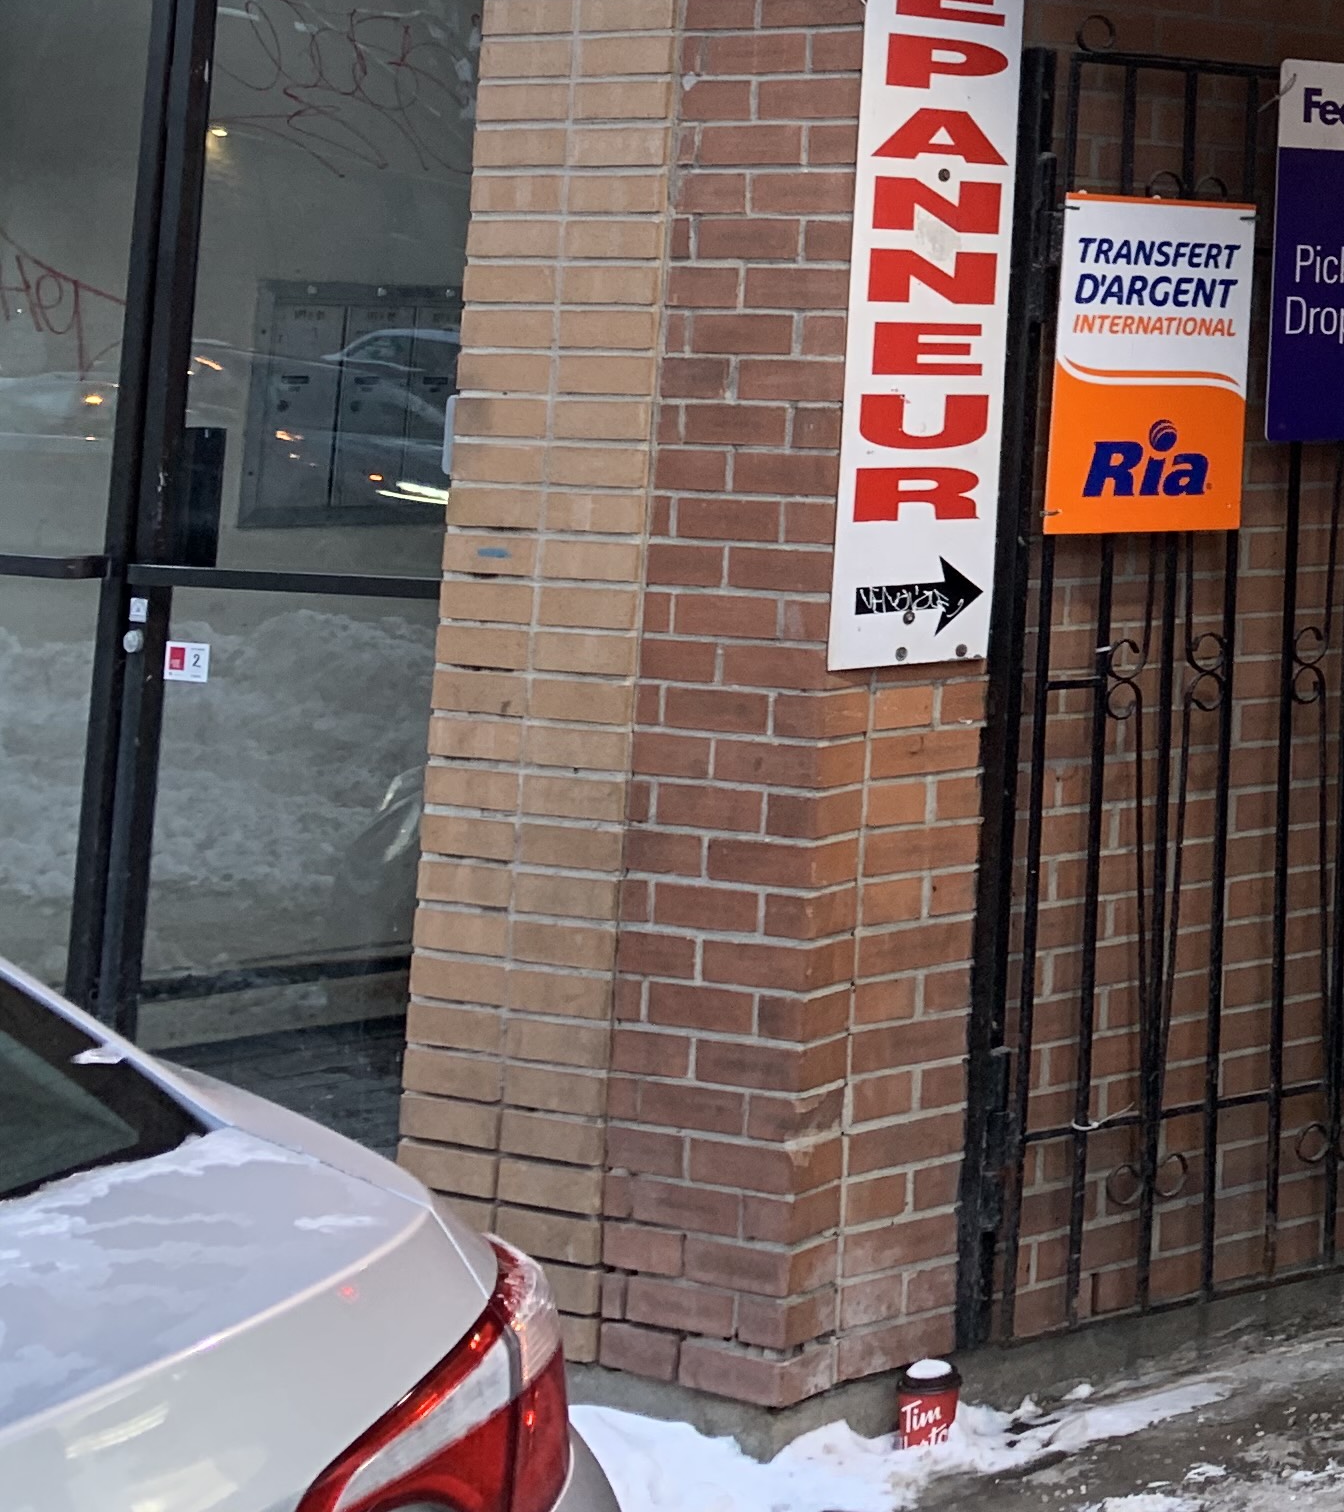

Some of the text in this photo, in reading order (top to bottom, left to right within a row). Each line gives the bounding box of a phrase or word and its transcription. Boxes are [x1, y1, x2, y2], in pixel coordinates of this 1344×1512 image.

[1077, 237, 1242, 270] TRANSFERT
[1074, 273, 1239, 309] D'ARGENT
[1072, 314, 1237, 337] INTERNATIONAL
[1081, 418, 1210, 498] Ria
[900, 1399, 942, 1434] Tim
